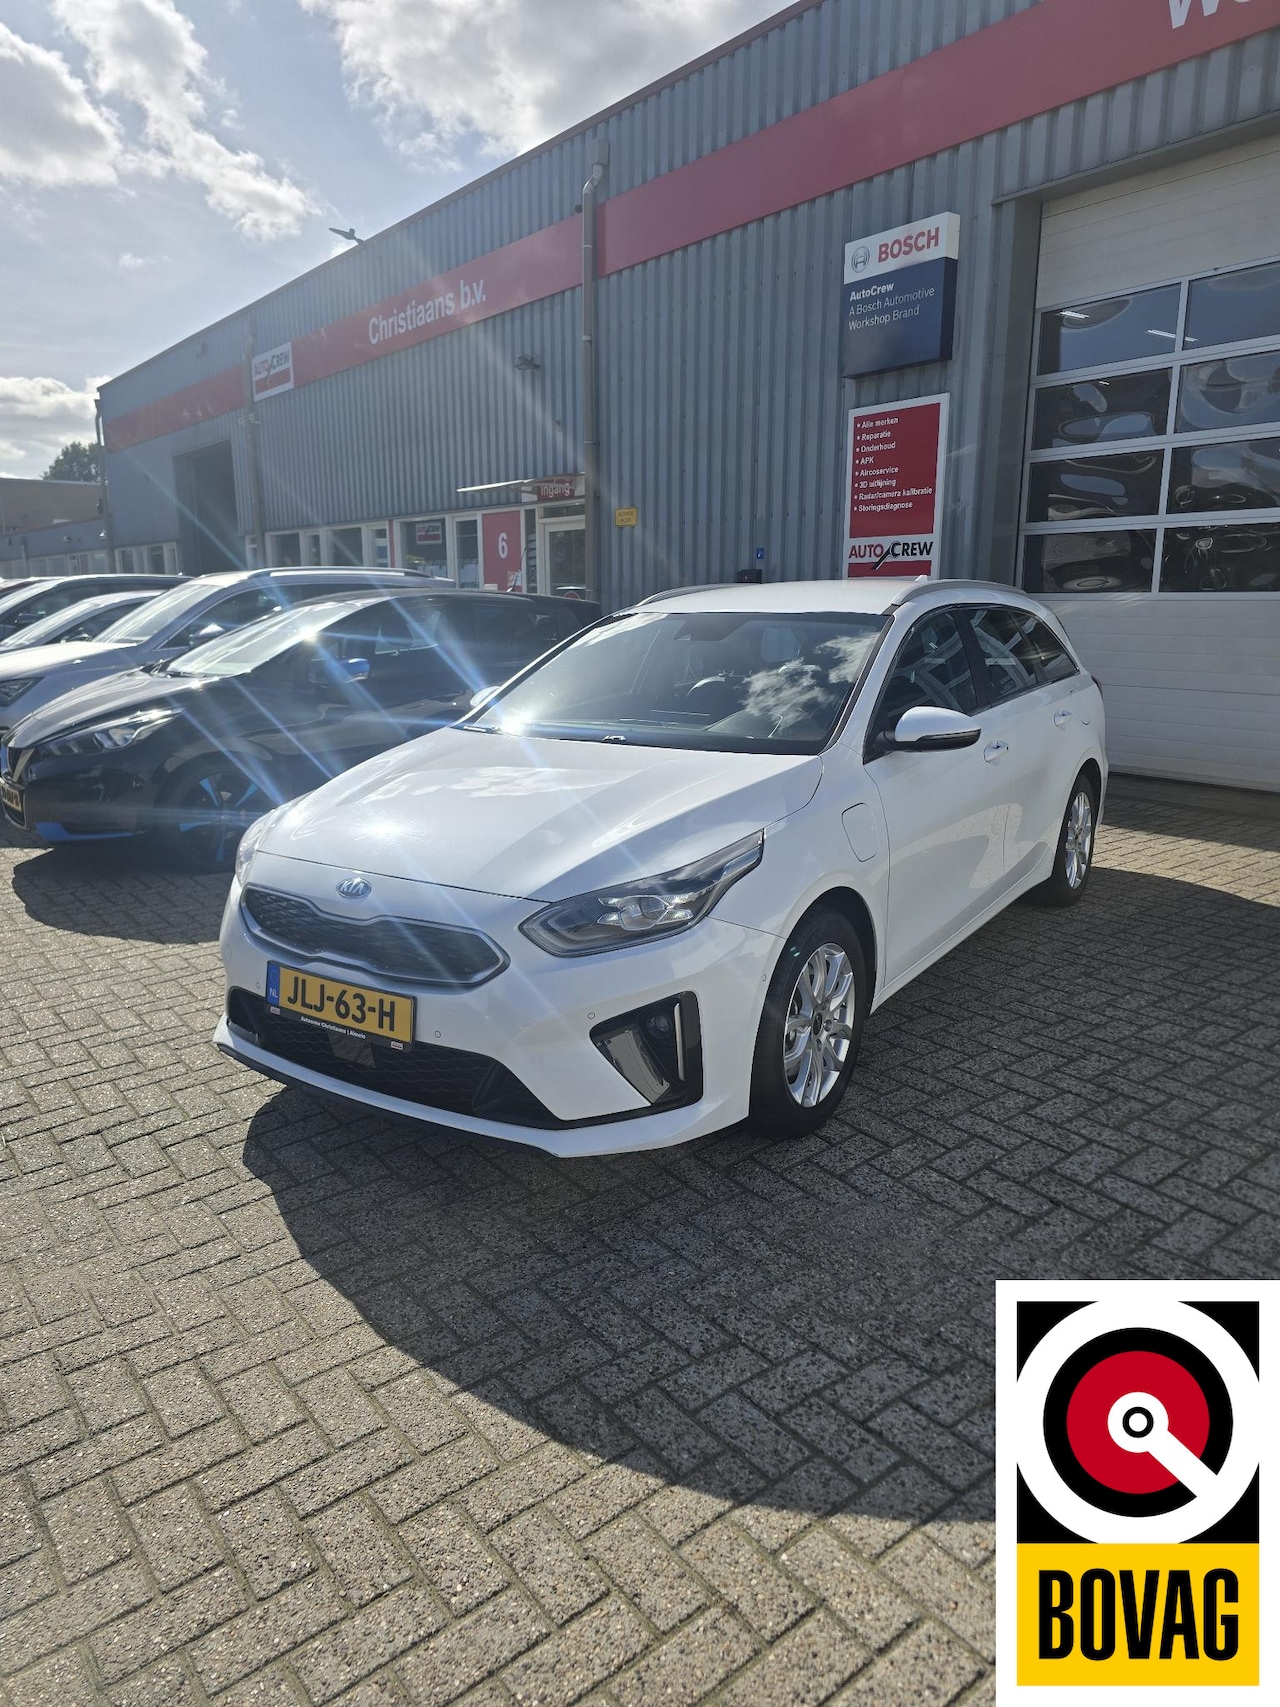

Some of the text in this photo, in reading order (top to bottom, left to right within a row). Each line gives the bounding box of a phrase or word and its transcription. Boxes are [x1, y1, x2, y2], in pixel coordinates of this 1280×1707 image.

[877, 227, 940, 263] BOSCH
[850, 282, 894, 302] AutoCrew
[849, 287, 935, 316] A Bosch Automotive
[368, 279, 487, 345] Christiaans b.v.
[848, 304, 920, 331] Workshop Brand
[861, 417, 899, 429] Alle merken
[861, 430, 892, 442] Reparatie
[860, 442, 896, 453] Onderhoud
[860, 456, 875, 465] APK
[859, 466, 899, 477] Aircoservice
[859, 479, 897, 489] 3D uitlijning
[541, 484, 570, 498] Ingang
[902, 486, 933, 496] kalibratie
[858, 501, 914, 512] Storingsdiagnose
[498, 532, 508, 558] 6
[849, 541, 934, 559] AUTO CREW
[269, 987, 279, 998] NL
[287, 976, 396, 1032] JLJ-63-H
